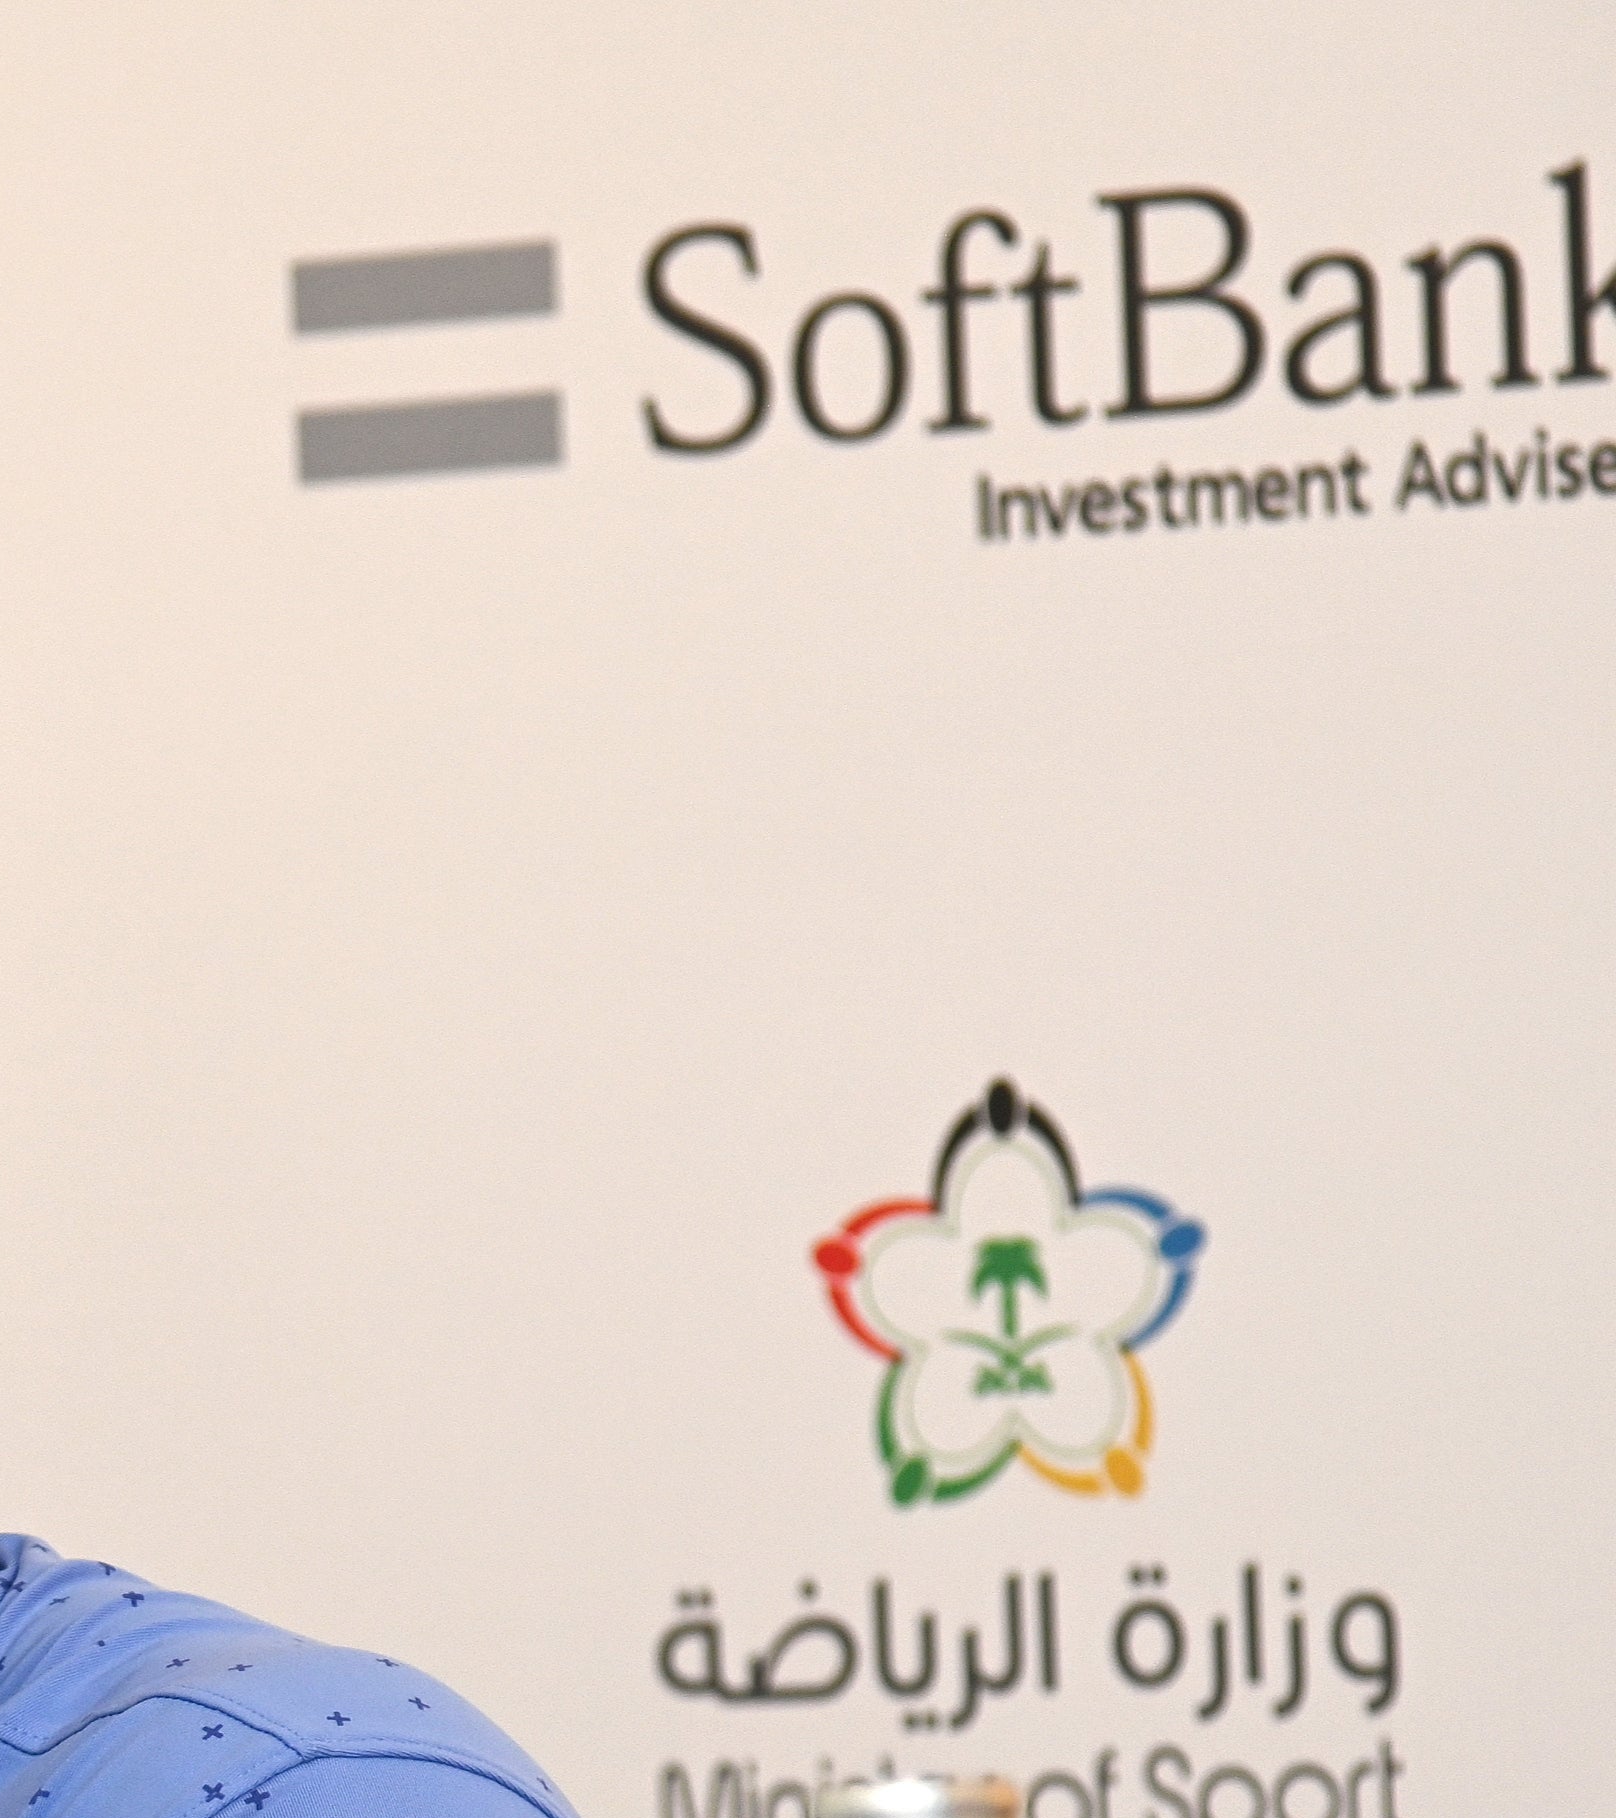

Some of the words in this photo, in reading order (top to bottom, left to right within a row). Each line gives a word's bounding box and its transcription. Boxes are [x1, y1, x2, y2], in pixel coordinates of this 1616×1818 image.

[639, 156, 1616, 458] SoftBank
[974, 448, 1373, 543] Investment
[655, 1568, 1061, 1732] الرياضة
[1110, 1560, 1402, 1720] وزارة
